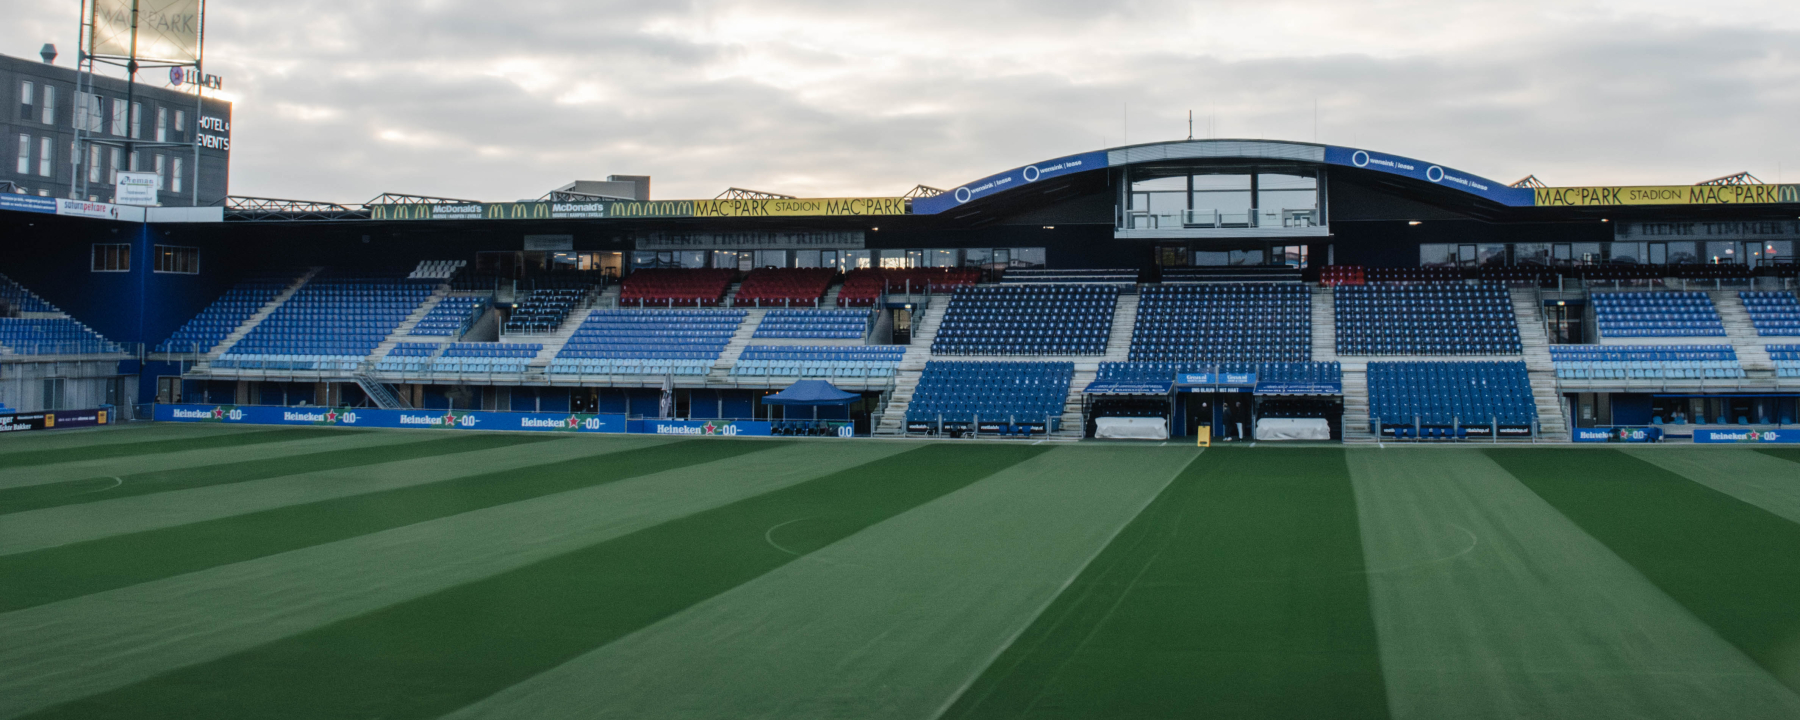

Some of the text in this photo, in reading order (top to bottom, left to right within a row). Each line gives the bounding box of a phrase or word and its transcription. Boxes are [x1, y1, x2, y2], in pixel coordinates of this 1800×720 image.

[197, 133, 230, 151] EVENTS
[1629, 189, 1682, 201] STADION
[432, 205, 483, 214] McDonald's
[552, 203, 604, 212] McDonald's
[775, 201, 821, 212] STADION
[173, 408, 212, 419] Heineken
[284, 411, 325, 422] Heineken
[400, 414, 442, 425] Heineken
[521, 417, 566, 428] Heineken
[657, 424, 702, 436] Heineken
[1710, 432, 1748, 441] Heineken
